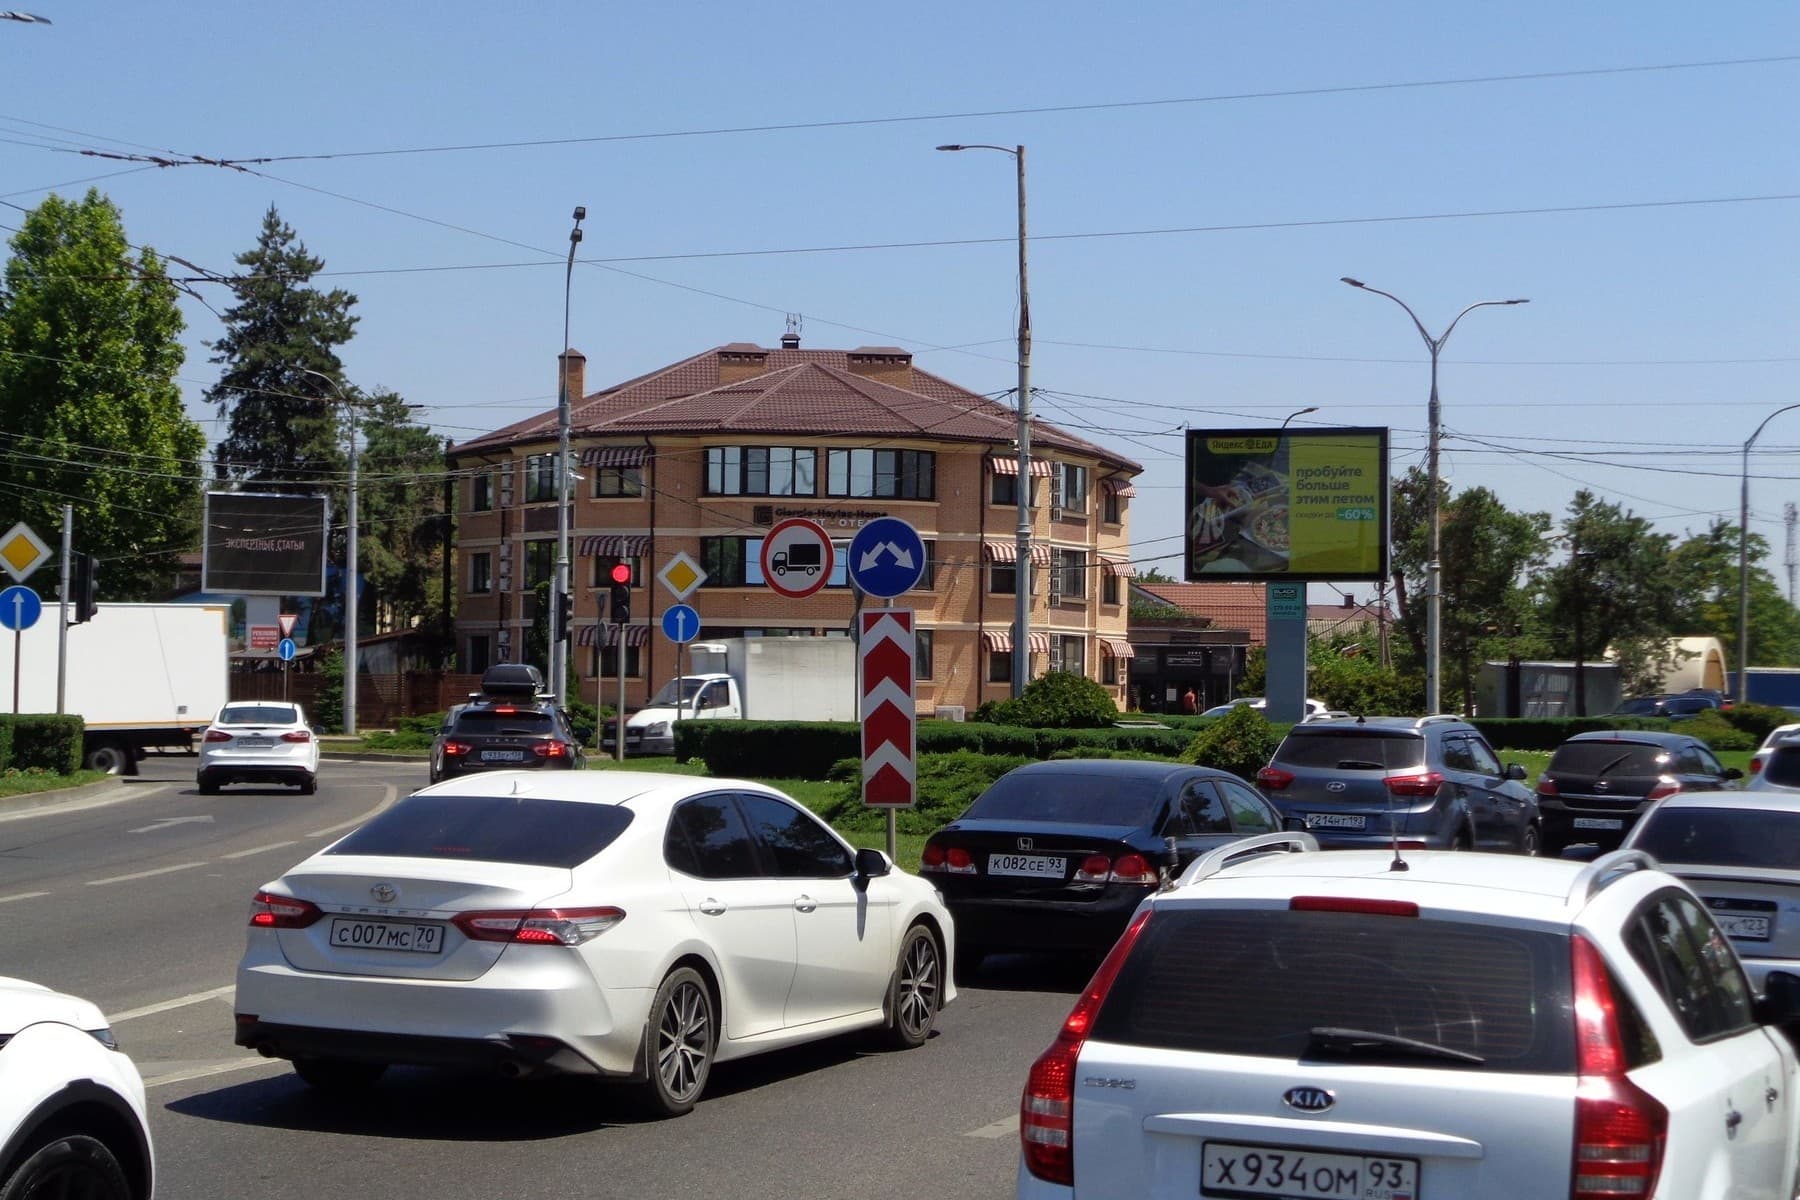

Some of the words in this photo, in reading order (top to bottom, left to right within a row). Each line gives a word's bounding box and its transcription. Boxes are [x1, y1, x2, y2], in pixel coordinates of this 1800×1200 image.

[1212, 440, 1244, 449] Яндекс
[1296, 465, 1362, 479] пробуйте
[1296, 479, 1350, 490] больше
[1296, 495, 1329, 504] этим
[1331, 495, 1375, 504] летом
[839, 518, 868, 527] ОТЕ
[1291, 1089, 1327, 1107] KIA
